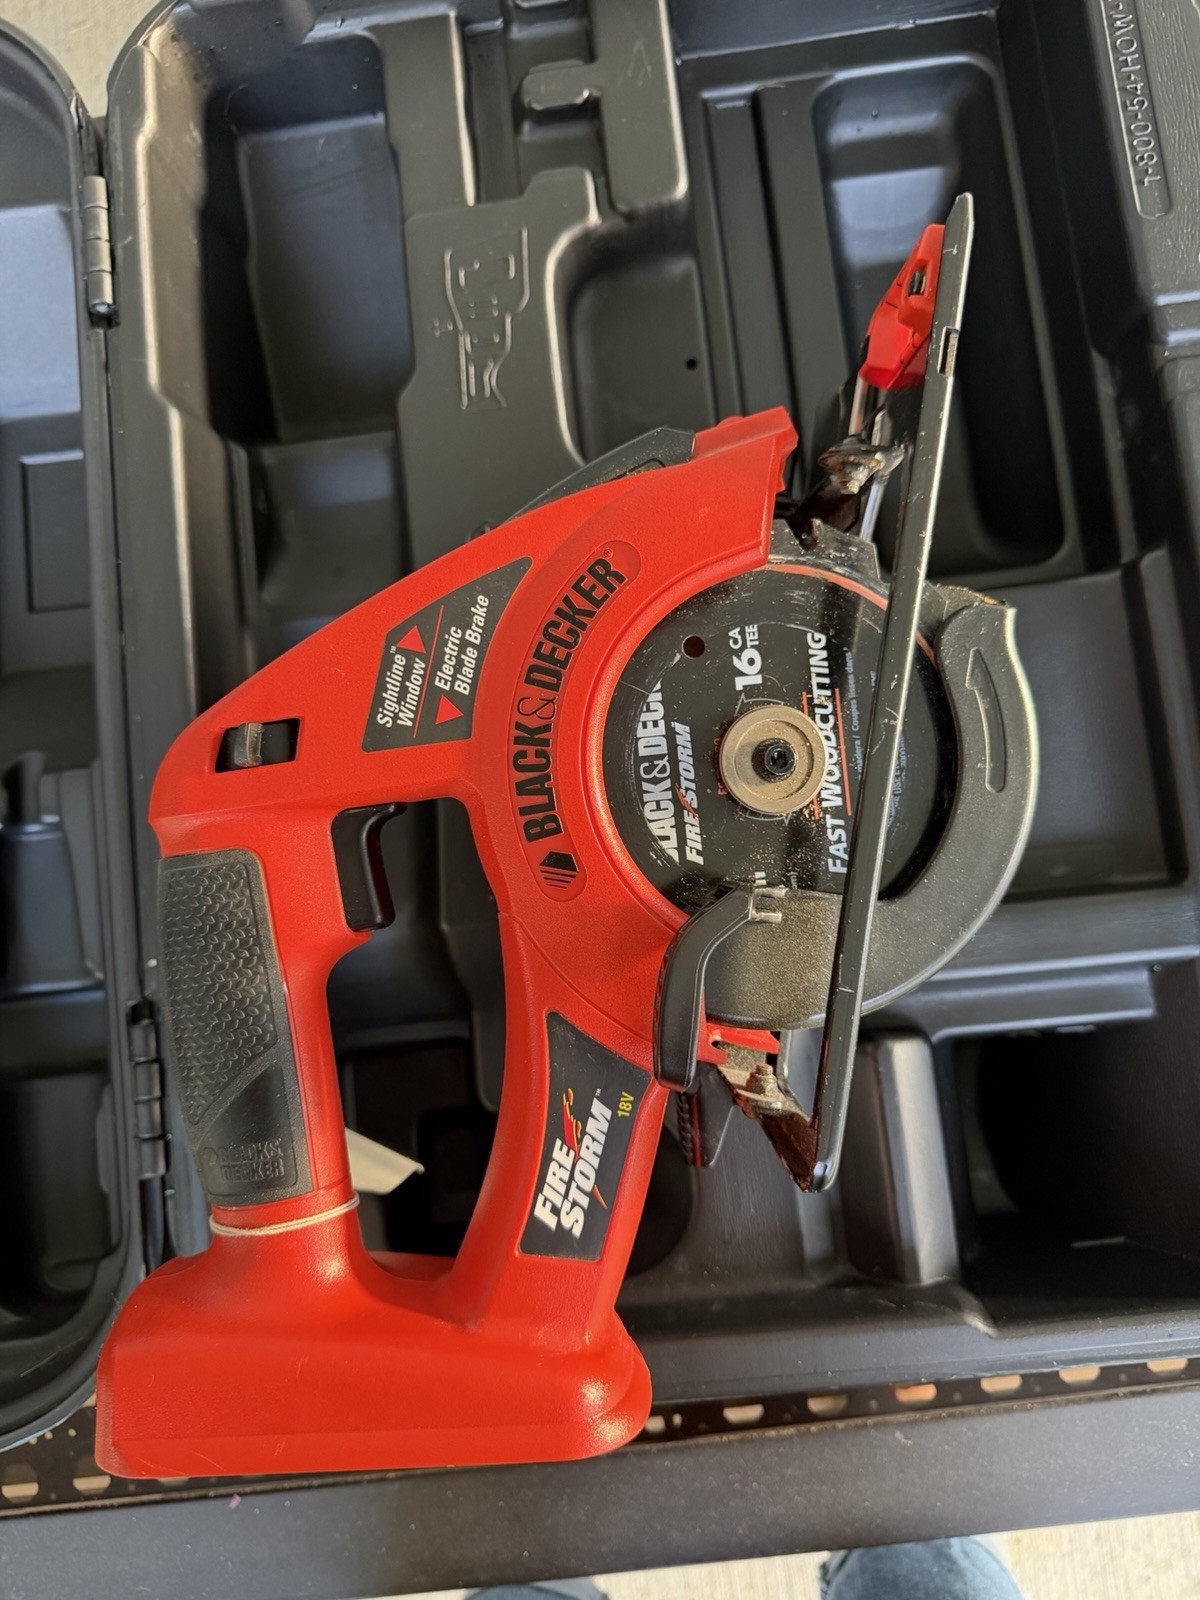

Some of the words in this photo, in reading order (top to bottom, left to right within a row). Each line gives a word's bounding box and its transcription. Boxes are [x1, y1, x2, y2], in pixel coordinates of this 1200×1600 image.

[1108, 0, 1161, 187] 1-800-54-HOW-
[465, 594, 490, 645] Brake
[435, 626, 463, 691] Electric
[454, 647, 478, 695] Blade
[733, 648, 762, 691] 16
[397, 657, 426, 728] Window
[825, 814, 849, 874] FAST
[616, 1090, 635, 1117] 18V
[533, 1137, 575, 1232] FIRE
